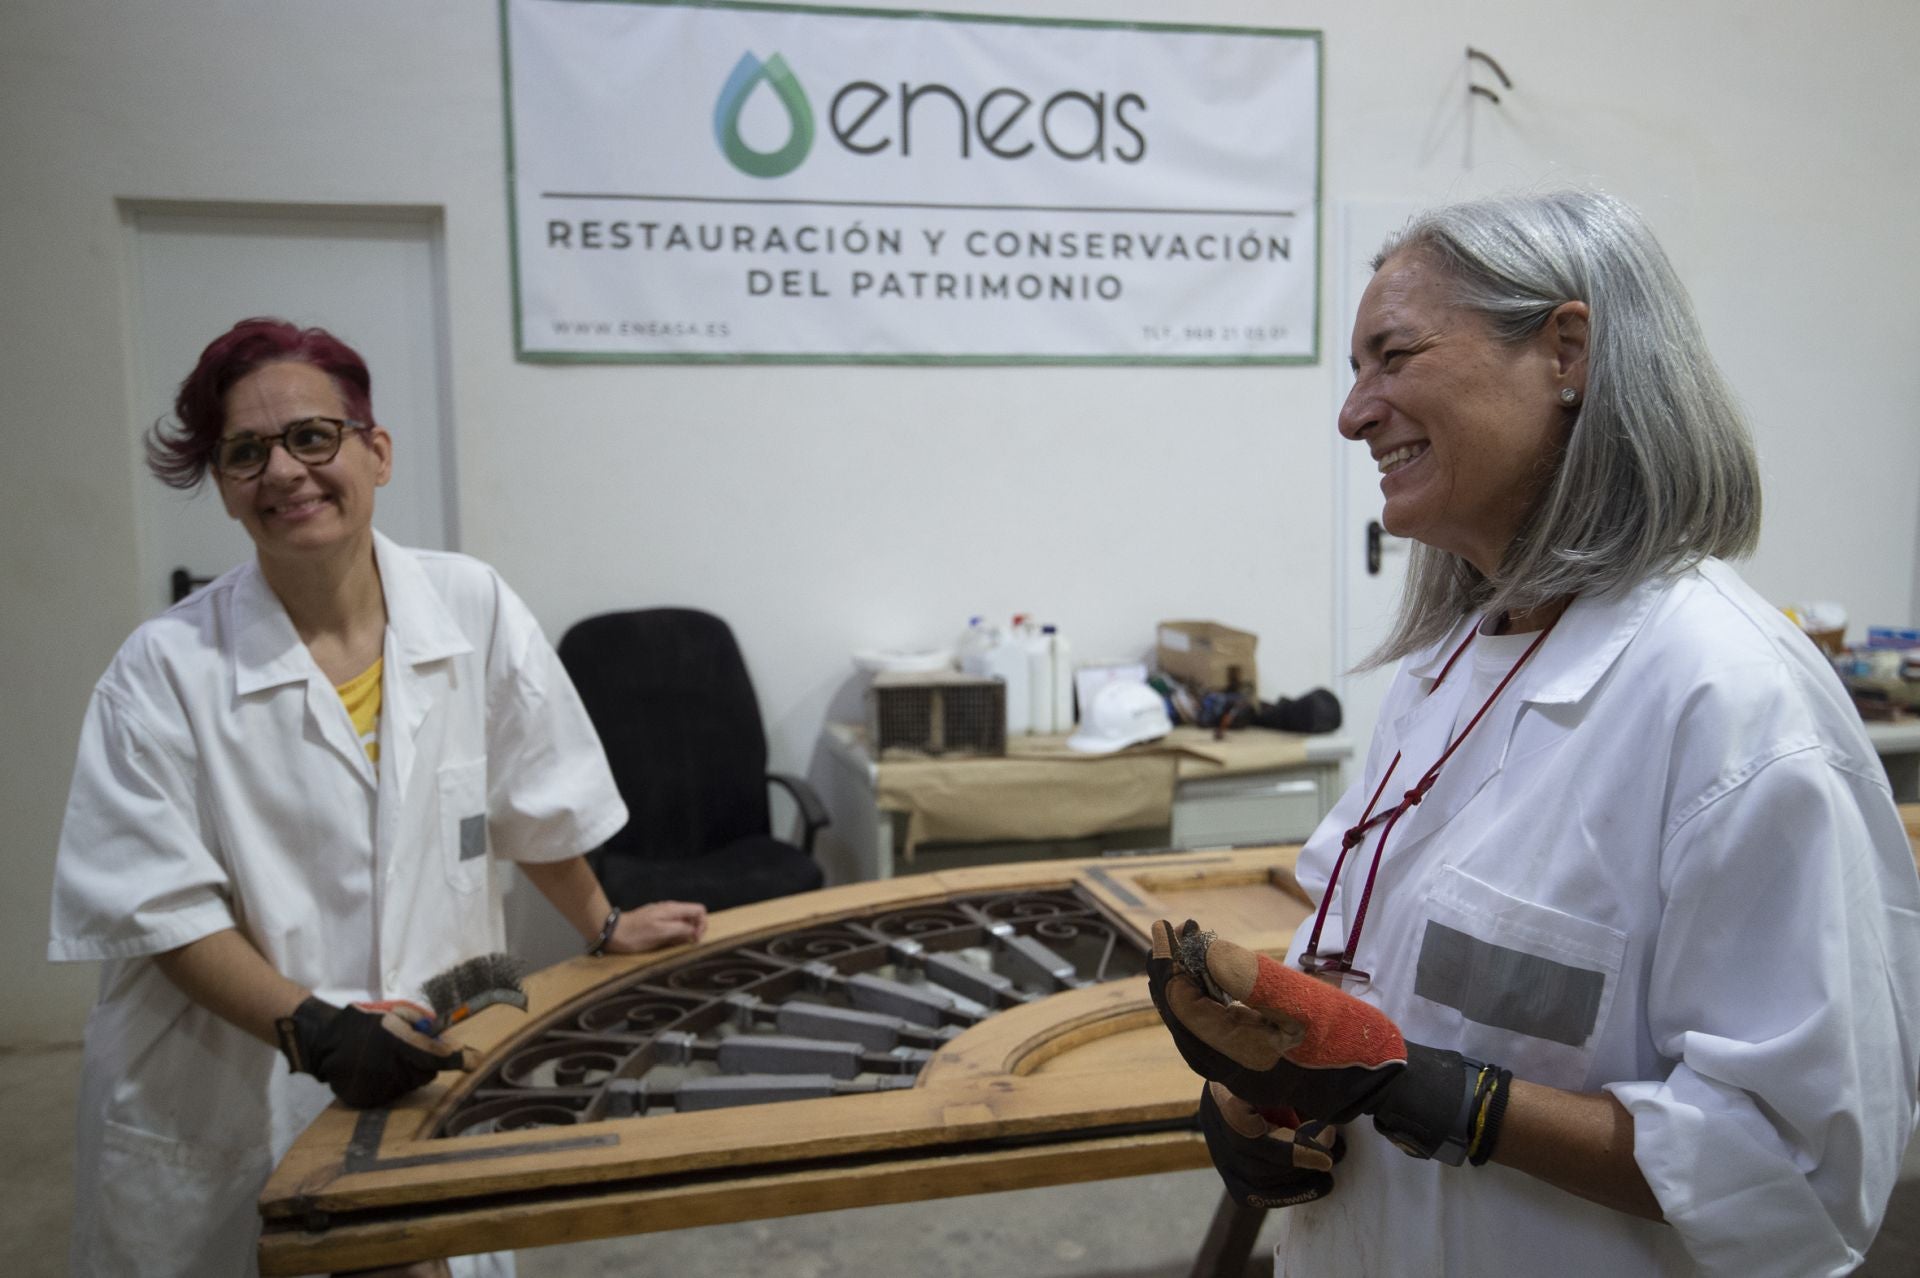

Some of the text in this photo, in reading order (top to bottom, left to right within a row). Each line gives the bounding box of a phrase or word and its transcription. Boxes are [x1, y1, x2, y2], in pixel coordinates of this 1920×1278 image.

[829, 81, 1147, 164] eneas
[548, 220, 1291, 262] RESTAURACIÓN Y CONSERVACIÓN
[748, 270, 1123, 300] DEL PATRIMONIO
